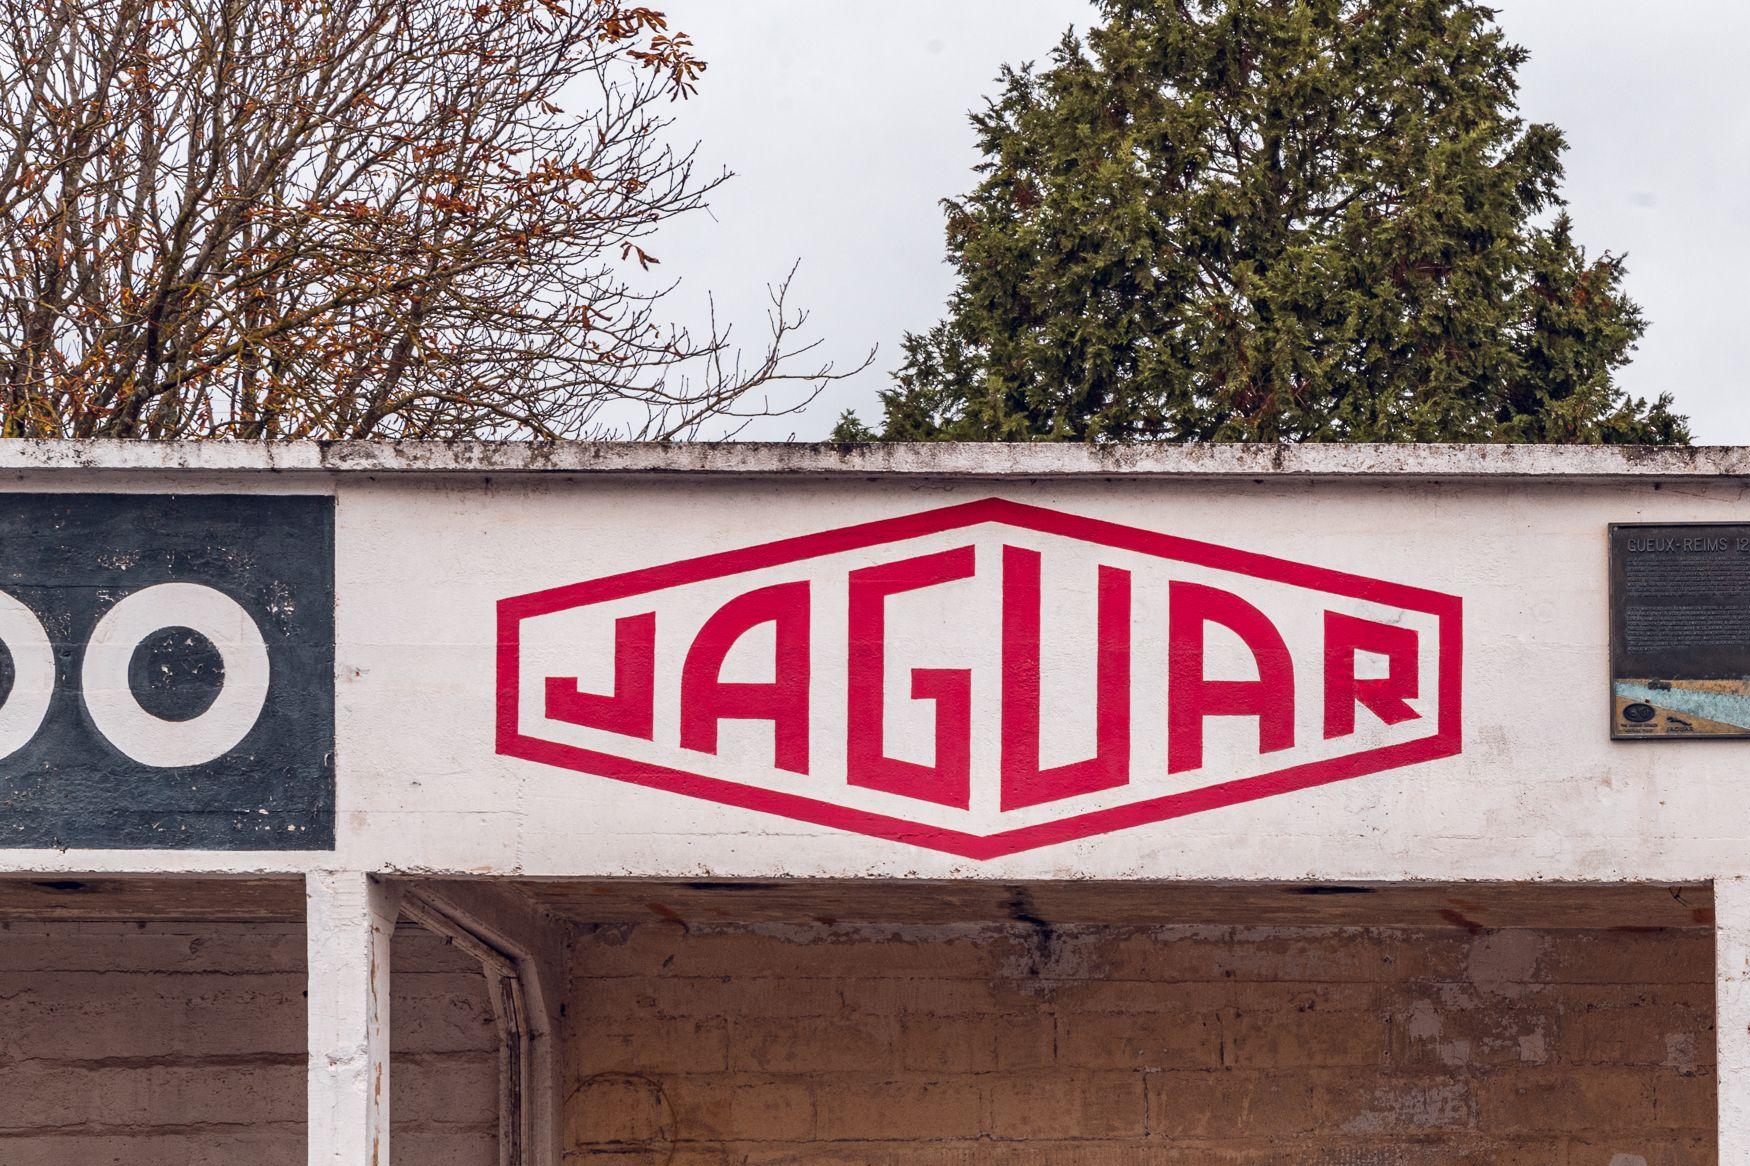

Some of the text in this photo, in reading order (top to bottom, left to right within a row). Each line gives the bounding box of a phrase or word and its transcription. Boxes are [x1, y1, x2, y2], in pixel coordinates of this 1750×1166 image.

[1627, 537, 1728, 552] GUEUX-REIMS
[1735, 537, 1750, 551] 12
[0, 582, 270, 768] O
[545, 545, 1421, 812] JAGUAR
